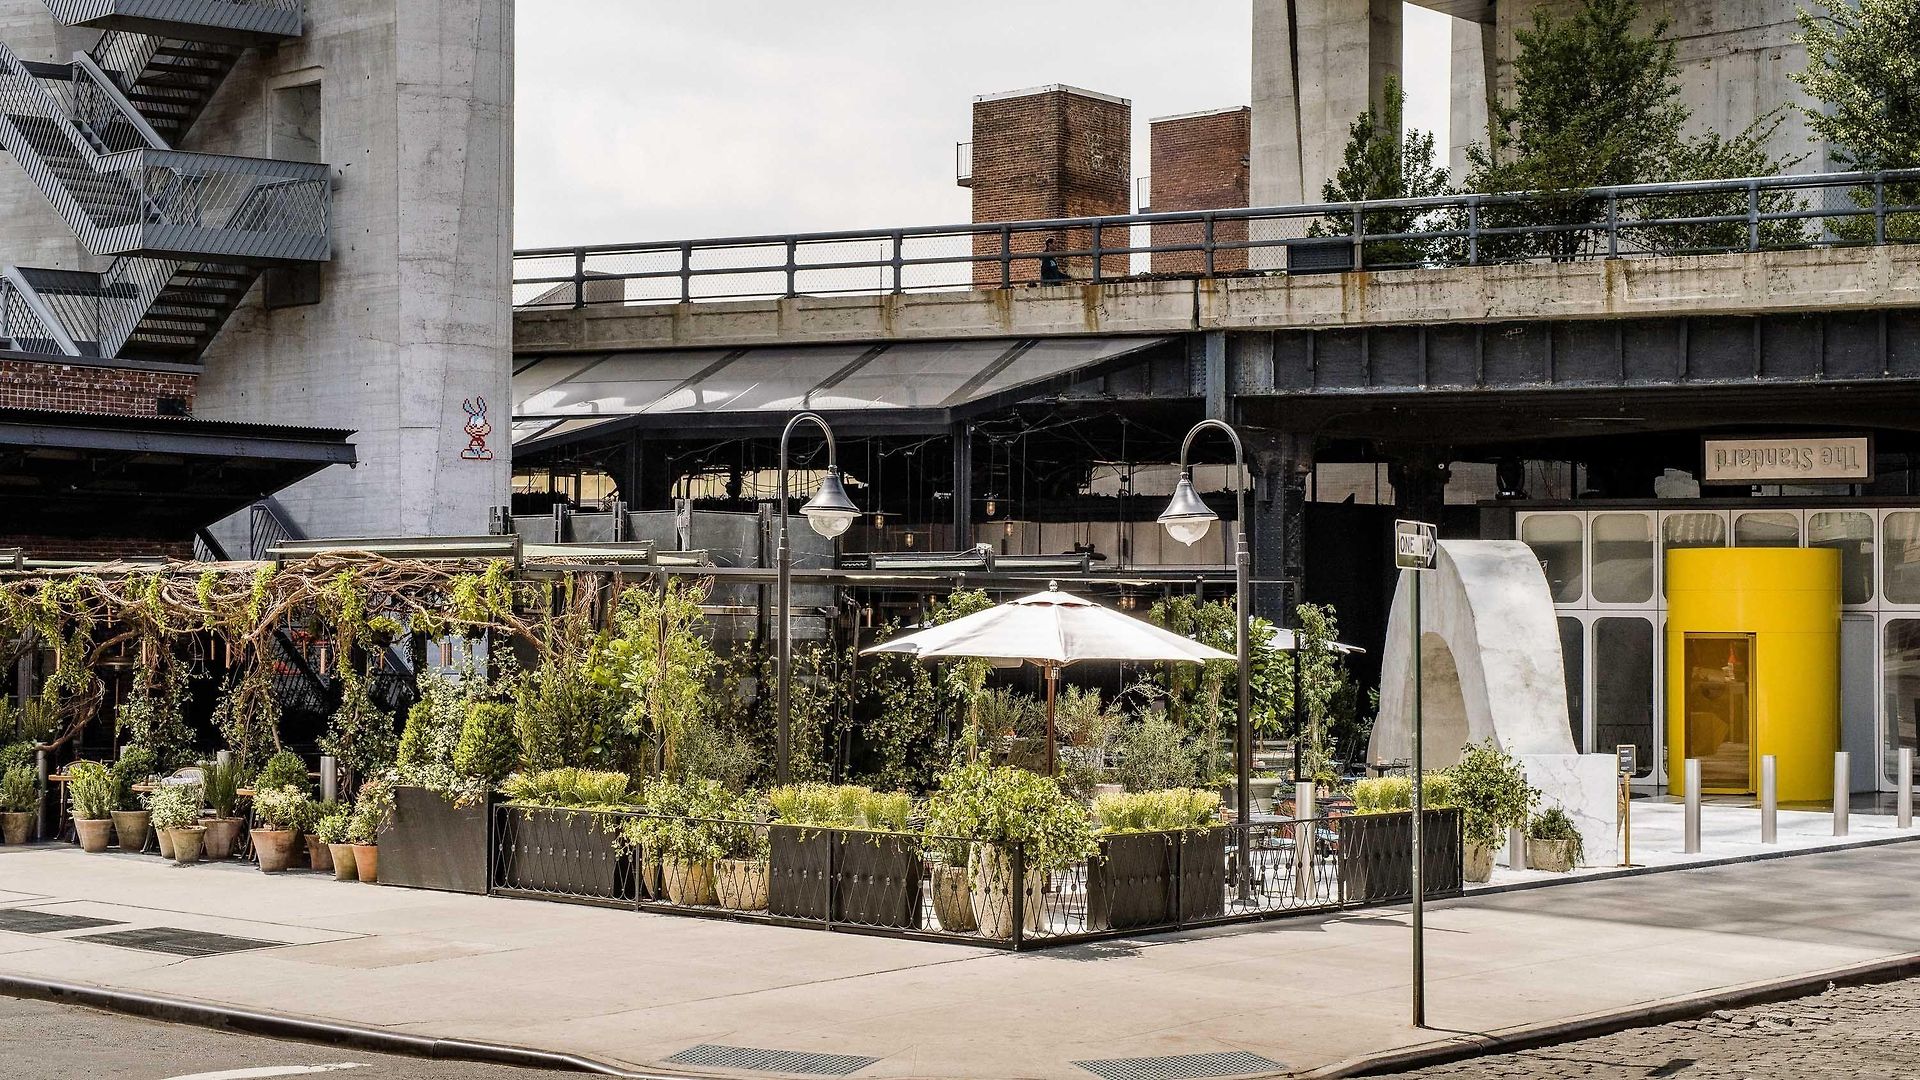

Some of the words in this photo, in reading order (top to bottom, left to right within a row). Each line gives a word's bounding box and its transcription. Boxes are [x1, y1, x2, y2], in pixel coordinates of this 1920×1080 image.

[1715, 446, 1813, 472] Standard
[1821, 446, 1860, 470] The
[1400, 535, 1415, 554] ONE
